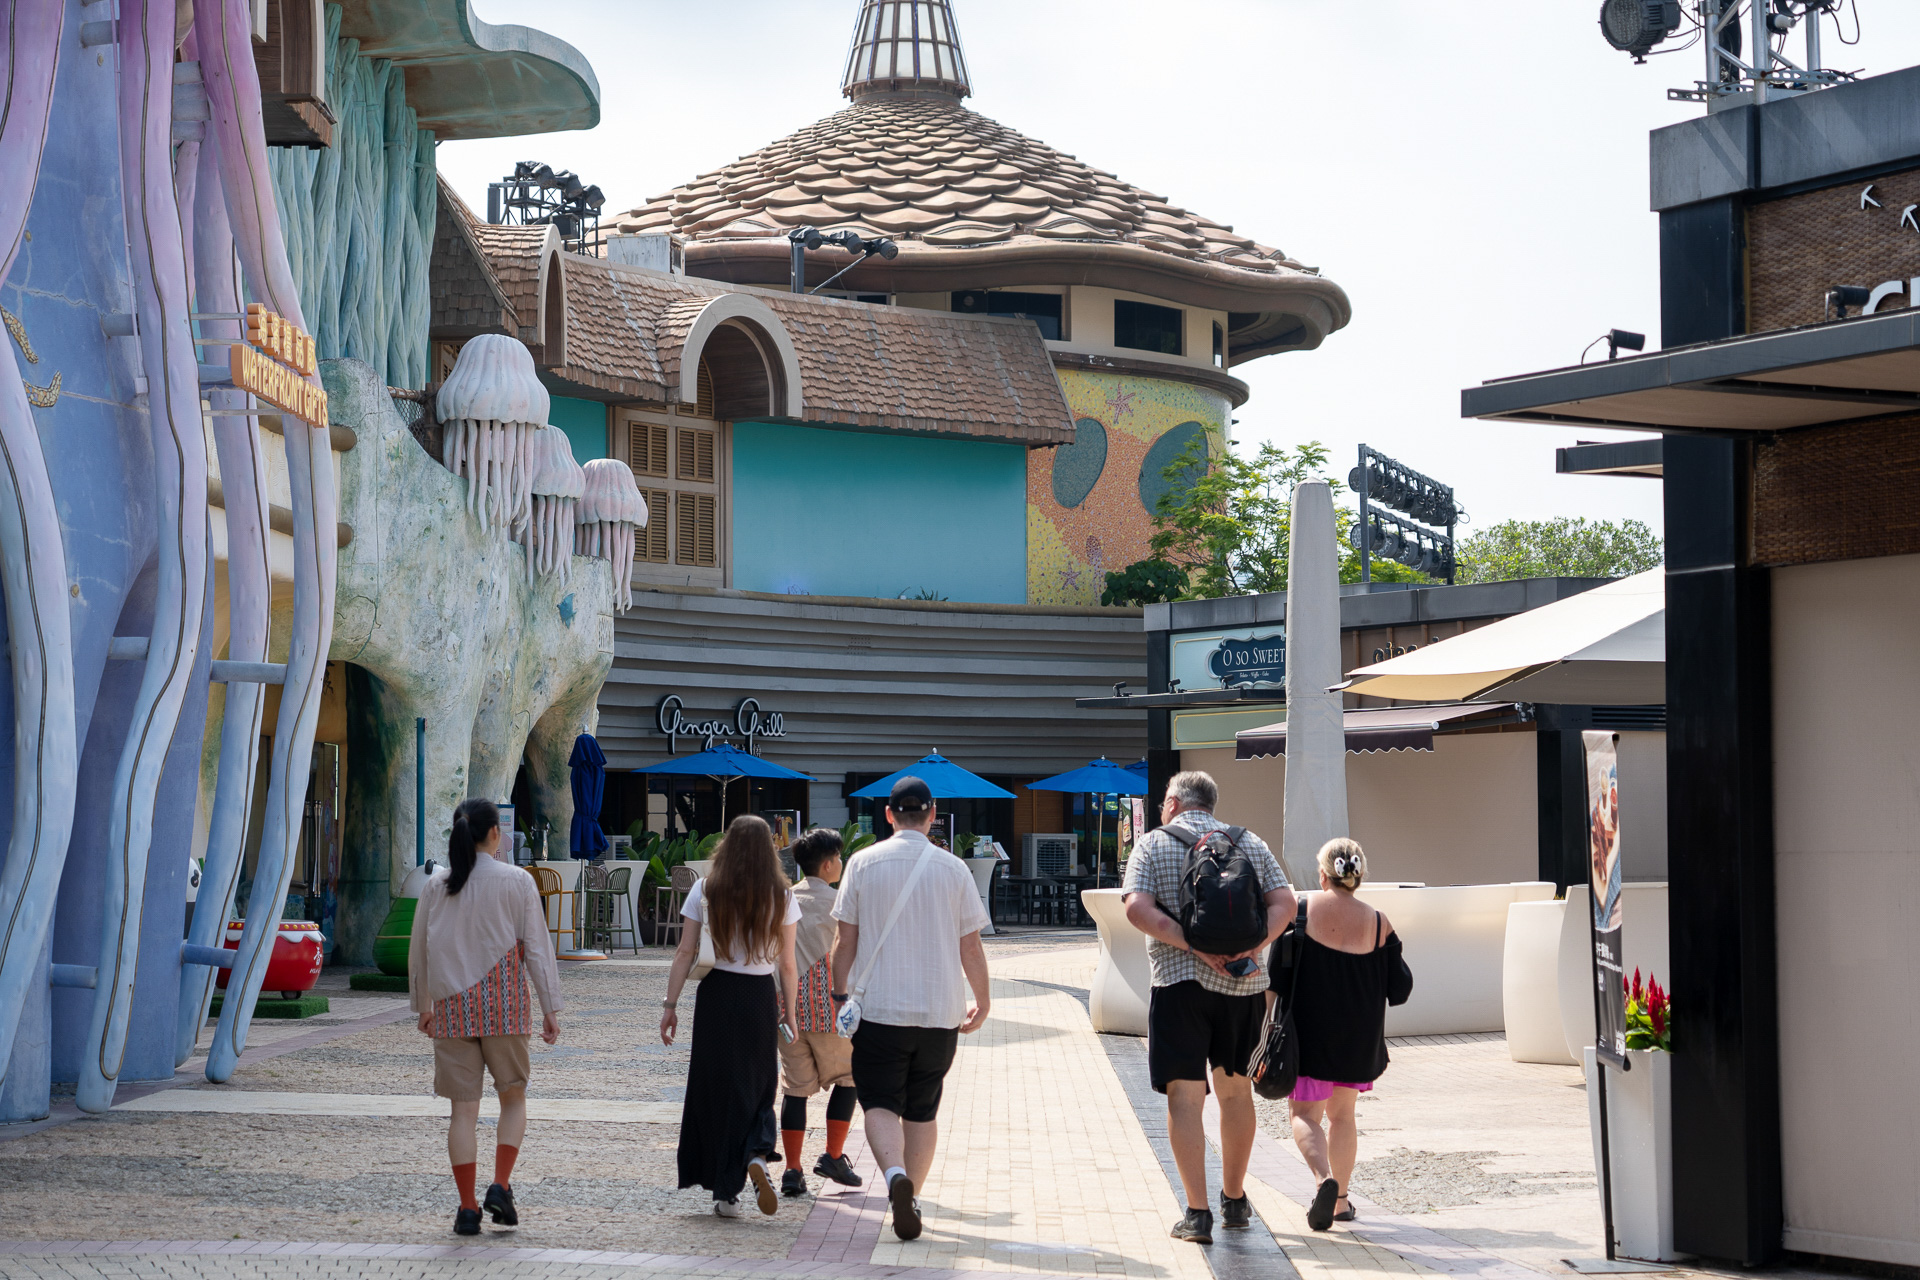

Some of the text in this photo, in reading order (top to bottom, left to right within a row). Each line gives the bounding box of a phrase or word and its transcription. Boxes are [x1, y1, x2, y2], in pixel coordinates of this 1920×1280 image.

[242, 344, 328, 428] WATERFRONT GIFTS
[1222, 649, 1233, 667] O
[659, 693, 788, 755] Ginger Grill
